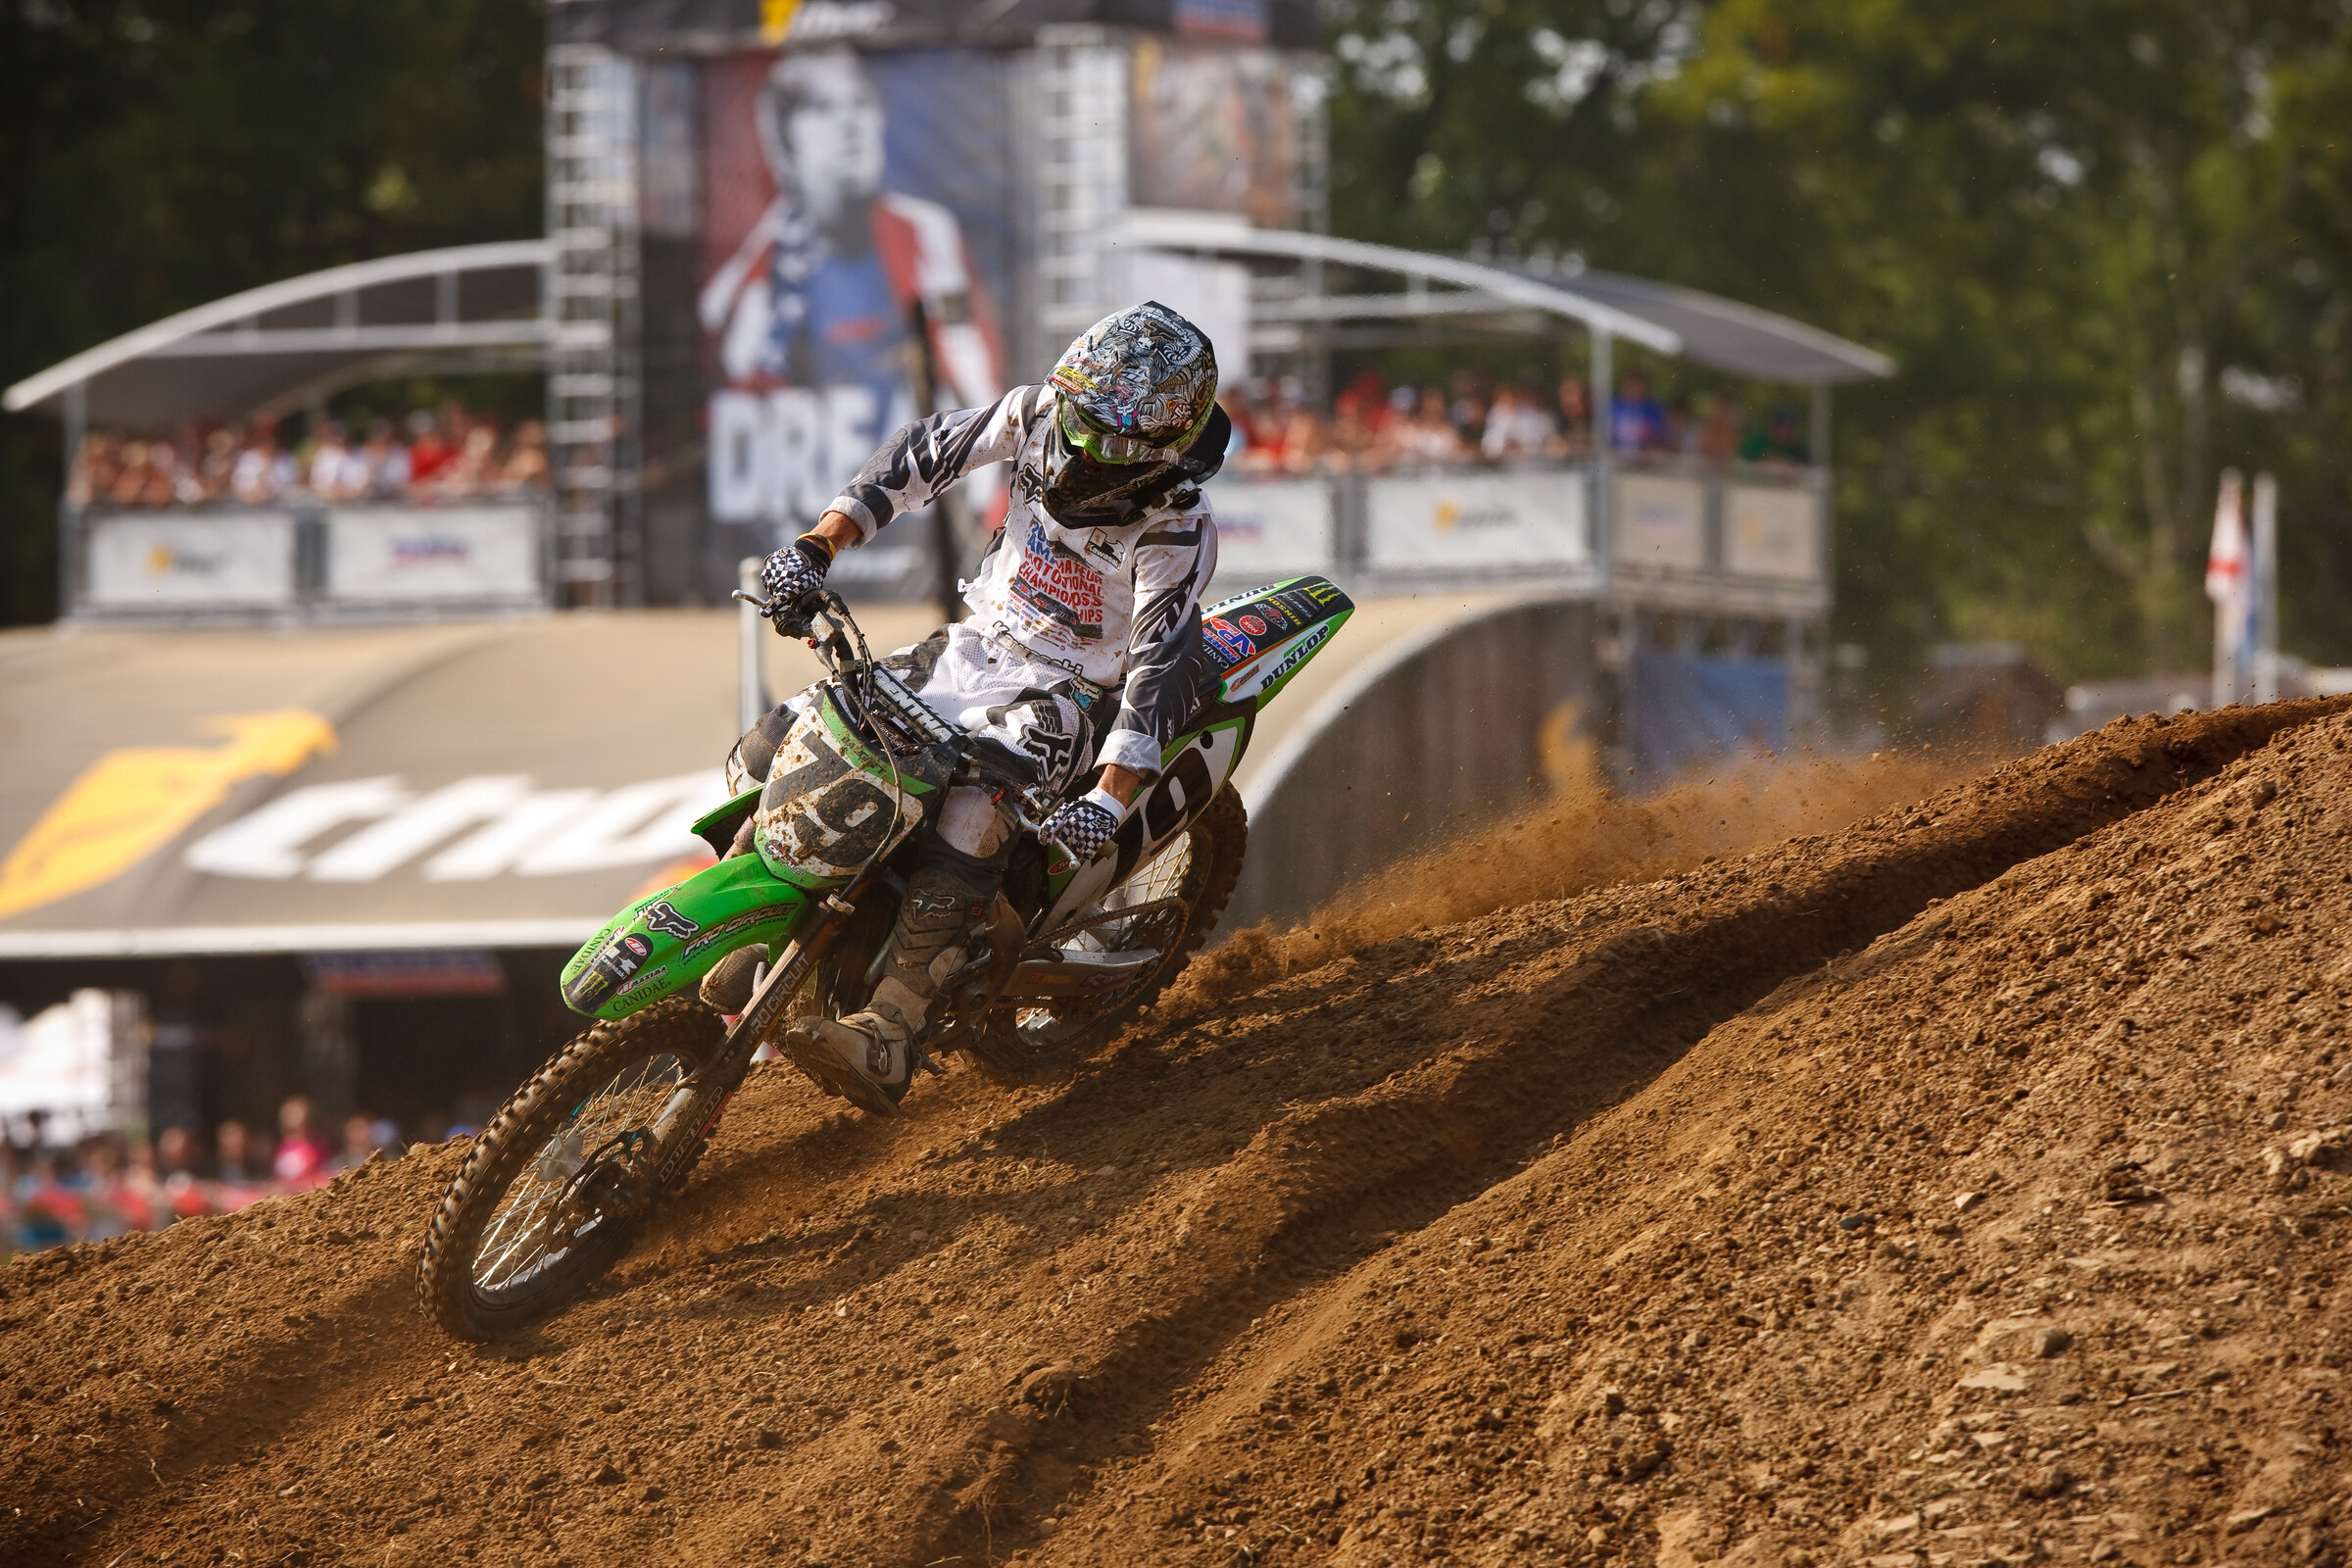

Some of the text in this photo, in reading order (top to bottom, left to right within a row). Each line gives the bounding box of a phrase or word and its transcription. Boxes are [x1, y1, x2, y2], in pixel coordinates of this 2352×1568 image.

[1089, 543, 1122, 570] Kawasaki
[1201, 584, 1276, 615] DUNLO
[1217, 629, 1251, 658] VP
[1243, 620, 1258, 634] NGK
[1202, 643, 1231, 670] CANID
[1260, 624, 1330, 692] DUNLOP
[873, 668, 954, 744] RENTHAL
[682, 904, 799, 959] PRO CIRCUIT
[632, 965, 667, 987] MAXIMA
[765, 952, 810, 1013] CIRCUIT
[612, 977, 668, 1012] CANIDAE
[660, 1086, 723, 1182] DUNLOP
